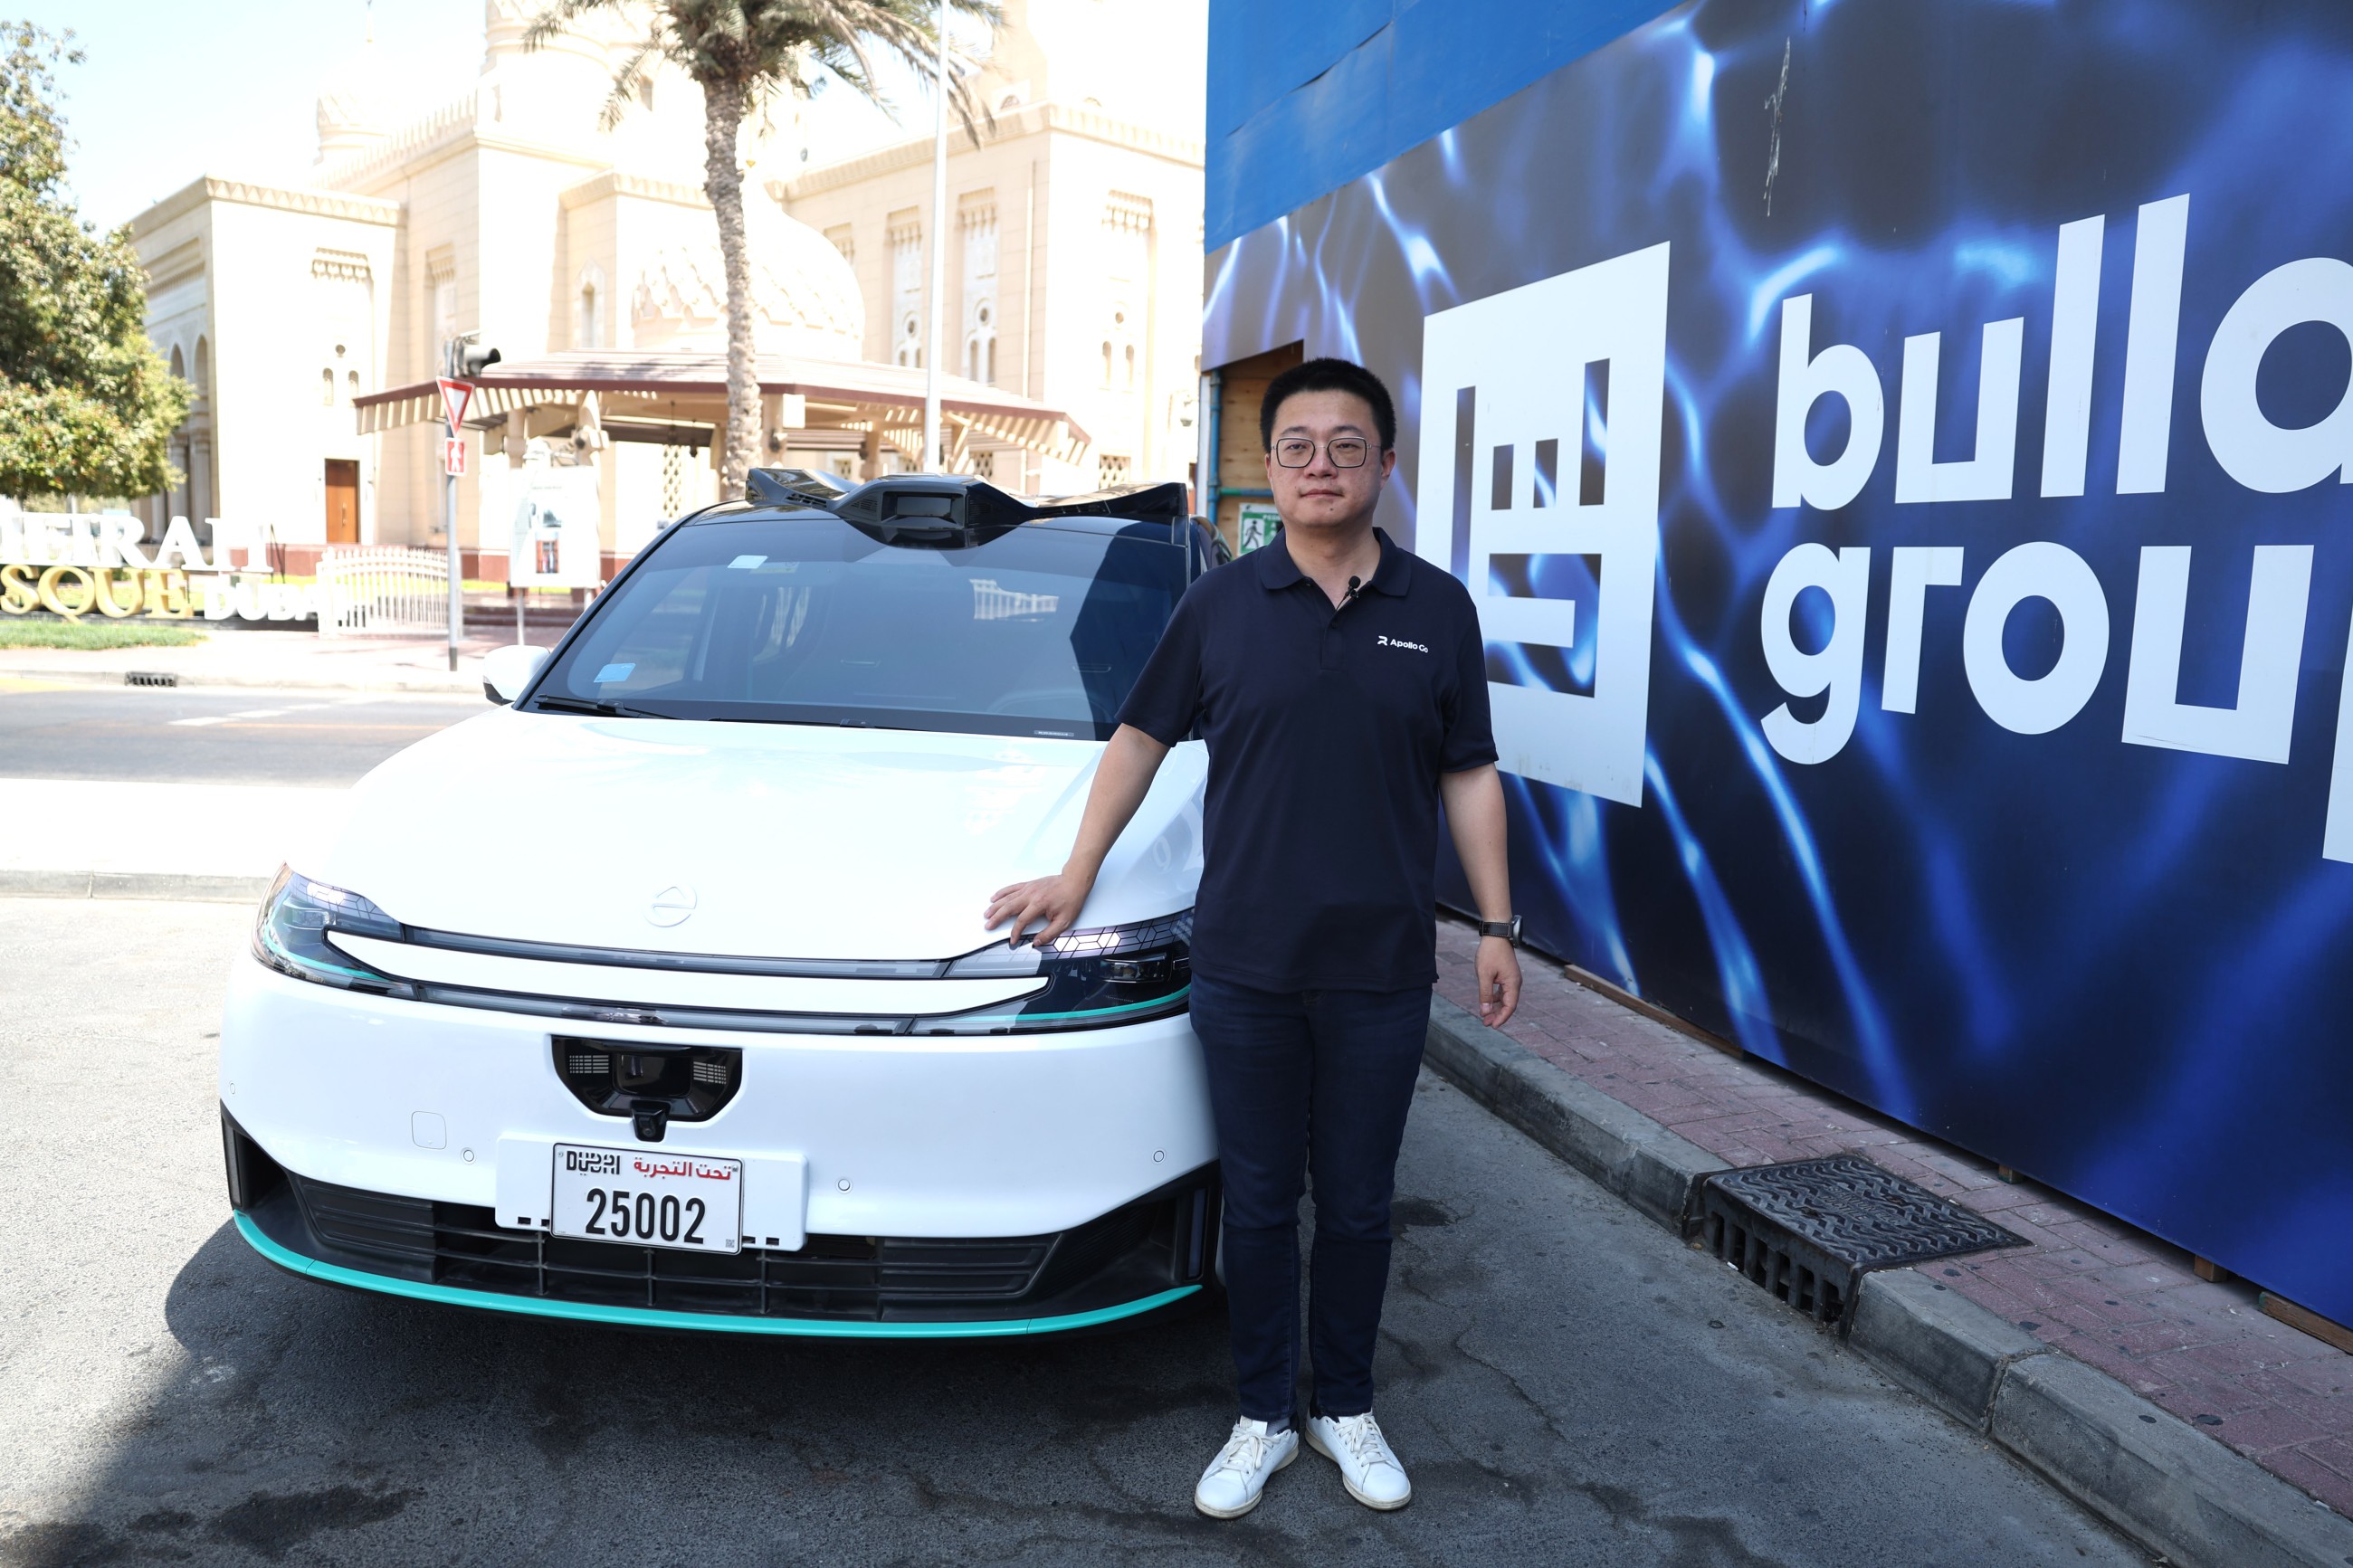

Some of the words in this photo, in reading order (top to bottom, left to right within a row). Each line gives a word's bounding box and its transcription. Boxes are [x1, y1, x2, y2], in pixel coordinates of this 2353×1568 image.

[1772, 193, 2353, 511] bulla
[0, 564, 194, 624] SQUE
[1389, 638, 1418, 650] Apollo
[1418, 644, 1429, 653] Go
[1760, 541, 2353, 865] grou
[633, 1156, 693, 1180] التجربة
[695, 1164, 732, 1182] تحت
[585, 1187, 706, 1245] 25002
